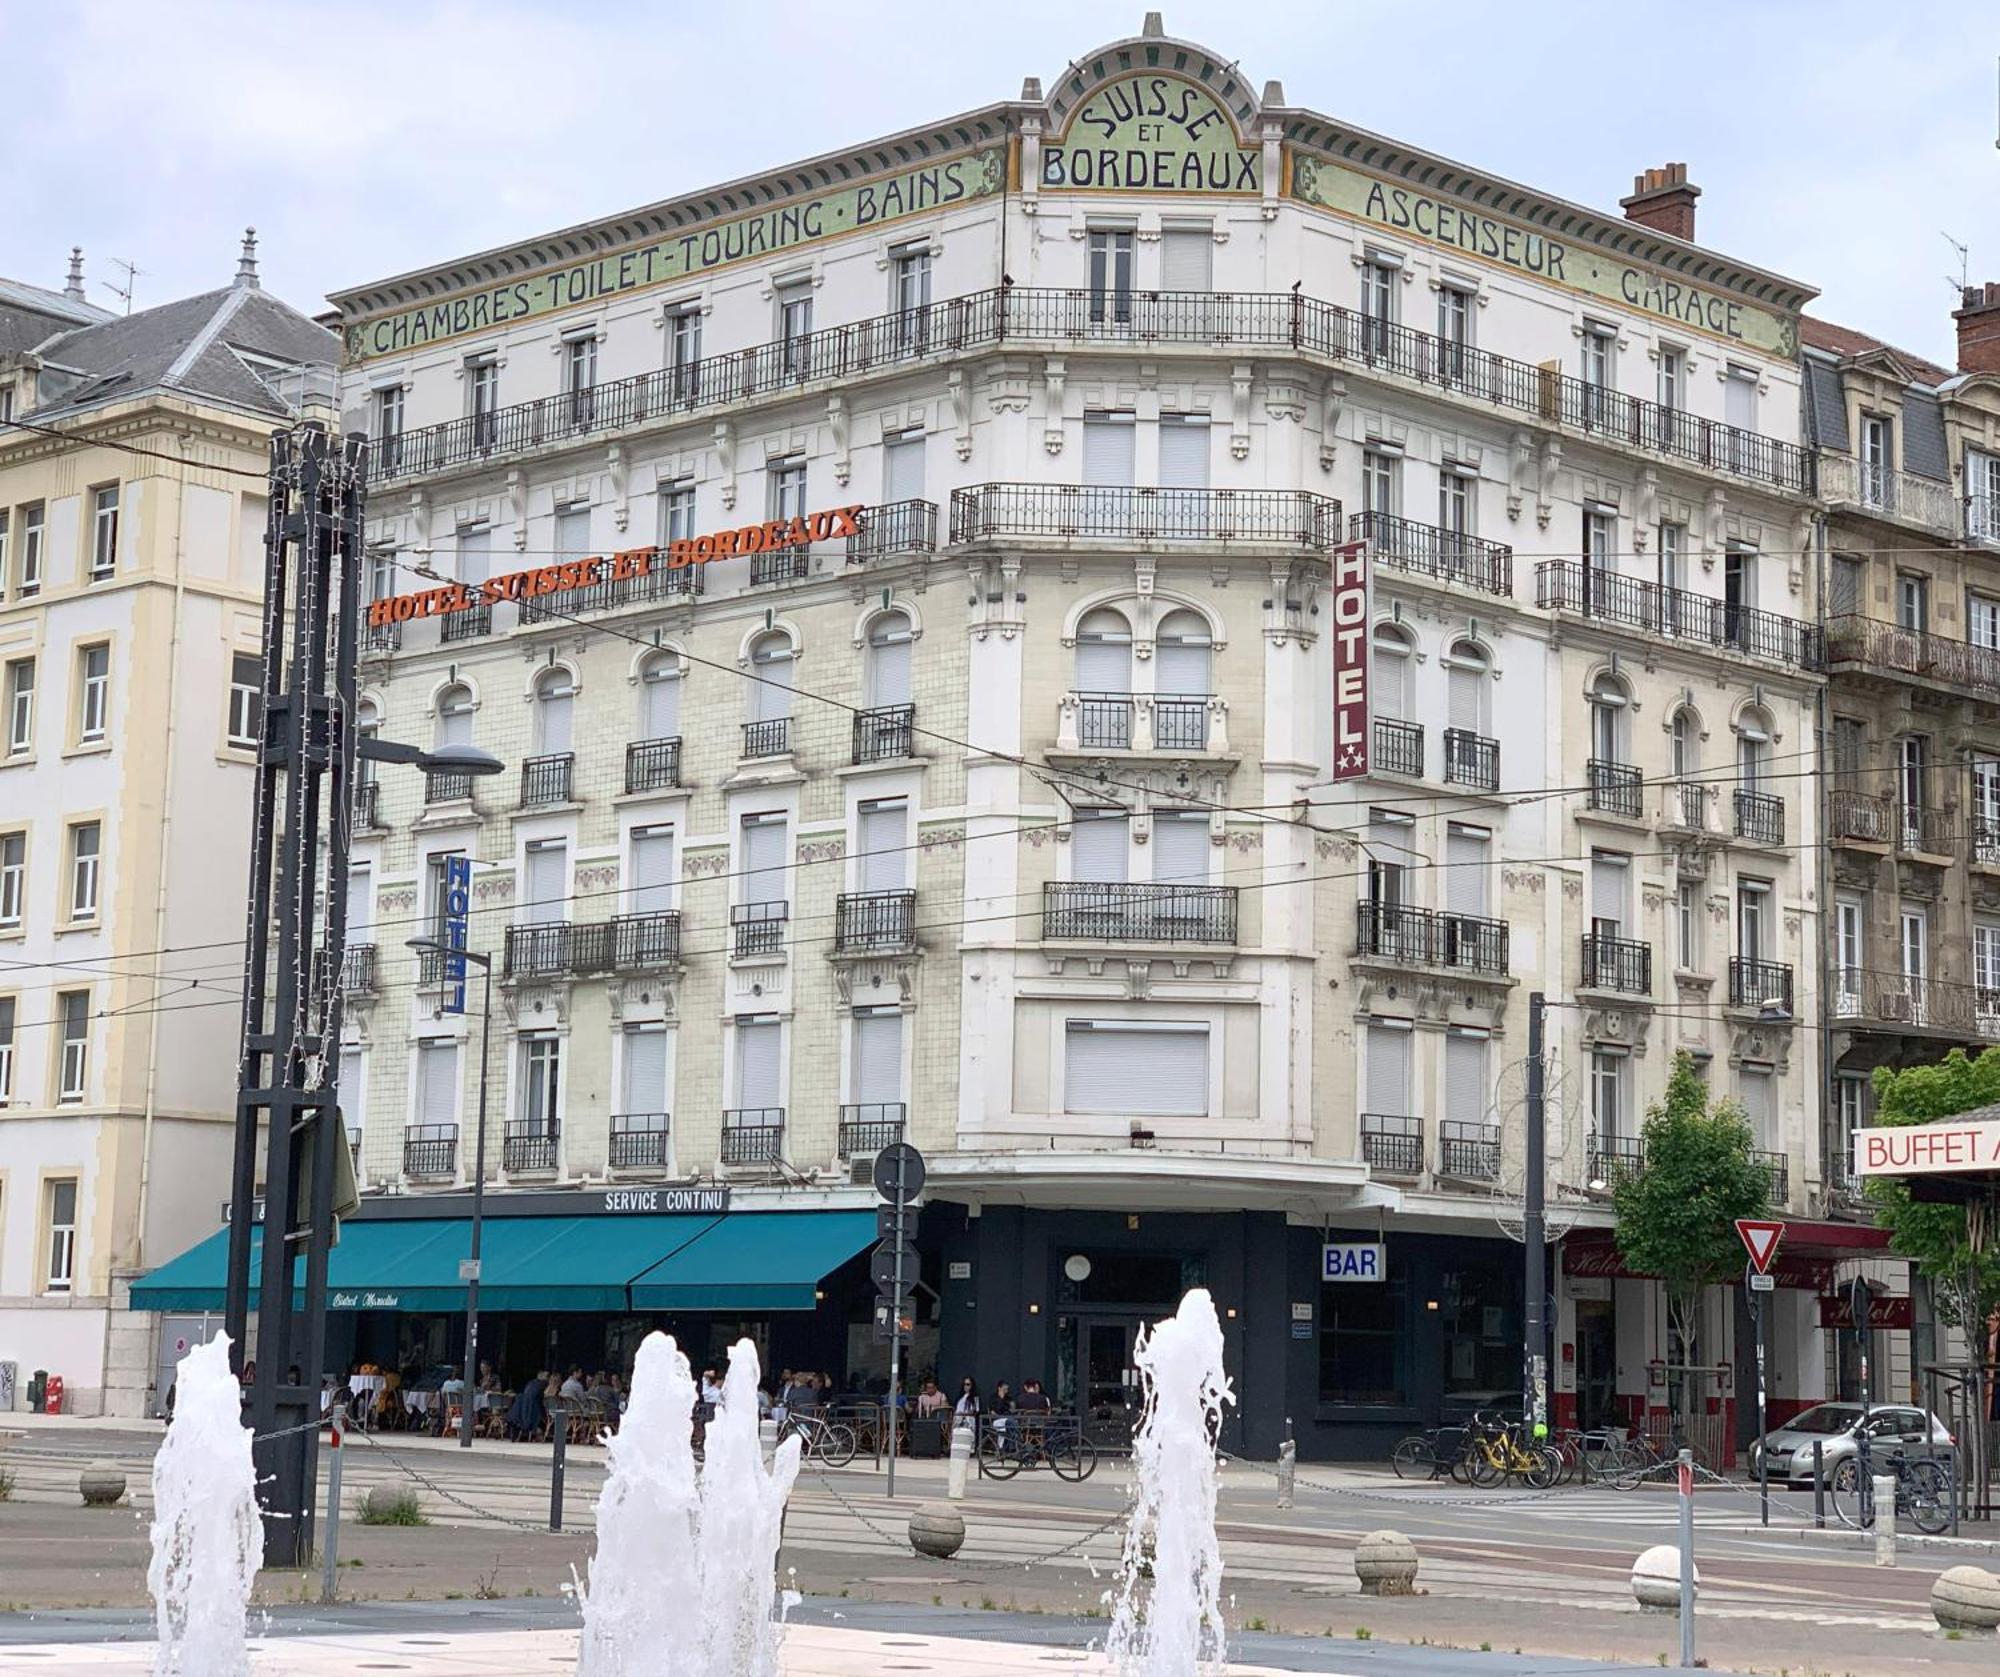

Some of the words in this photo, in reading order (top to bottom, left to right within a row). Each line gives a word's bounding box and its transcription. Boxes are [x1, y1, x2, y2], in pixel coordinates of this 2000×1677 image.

[1081, 79, 1225, 142] SUISSE
[1138, 124, 1165, 142] ET
[856, 162, 965, 226] BAINS
[1043, 148, 1259, 190] BORDEAUX
[1366, 182, 1566, 281] ASCENSEUR
[368, 583, 473, 628] HOTEL
[479, 556, 604, 608] SUISSE
[612, 546, 659, 582] ET
[667, 504, 865, 570] BORDEAUX
[1335, 548, 1367, 745] HOTEL
[441, 856, 470, 1013] HOTEL
[1868, 1130, 1983, 1168] BUFFET
[605, 1192, 658, 1210] SERVICE
[666, 1191, 722, 1210] CONTINU
[1326, 1249, 1377, 1275] BAR
